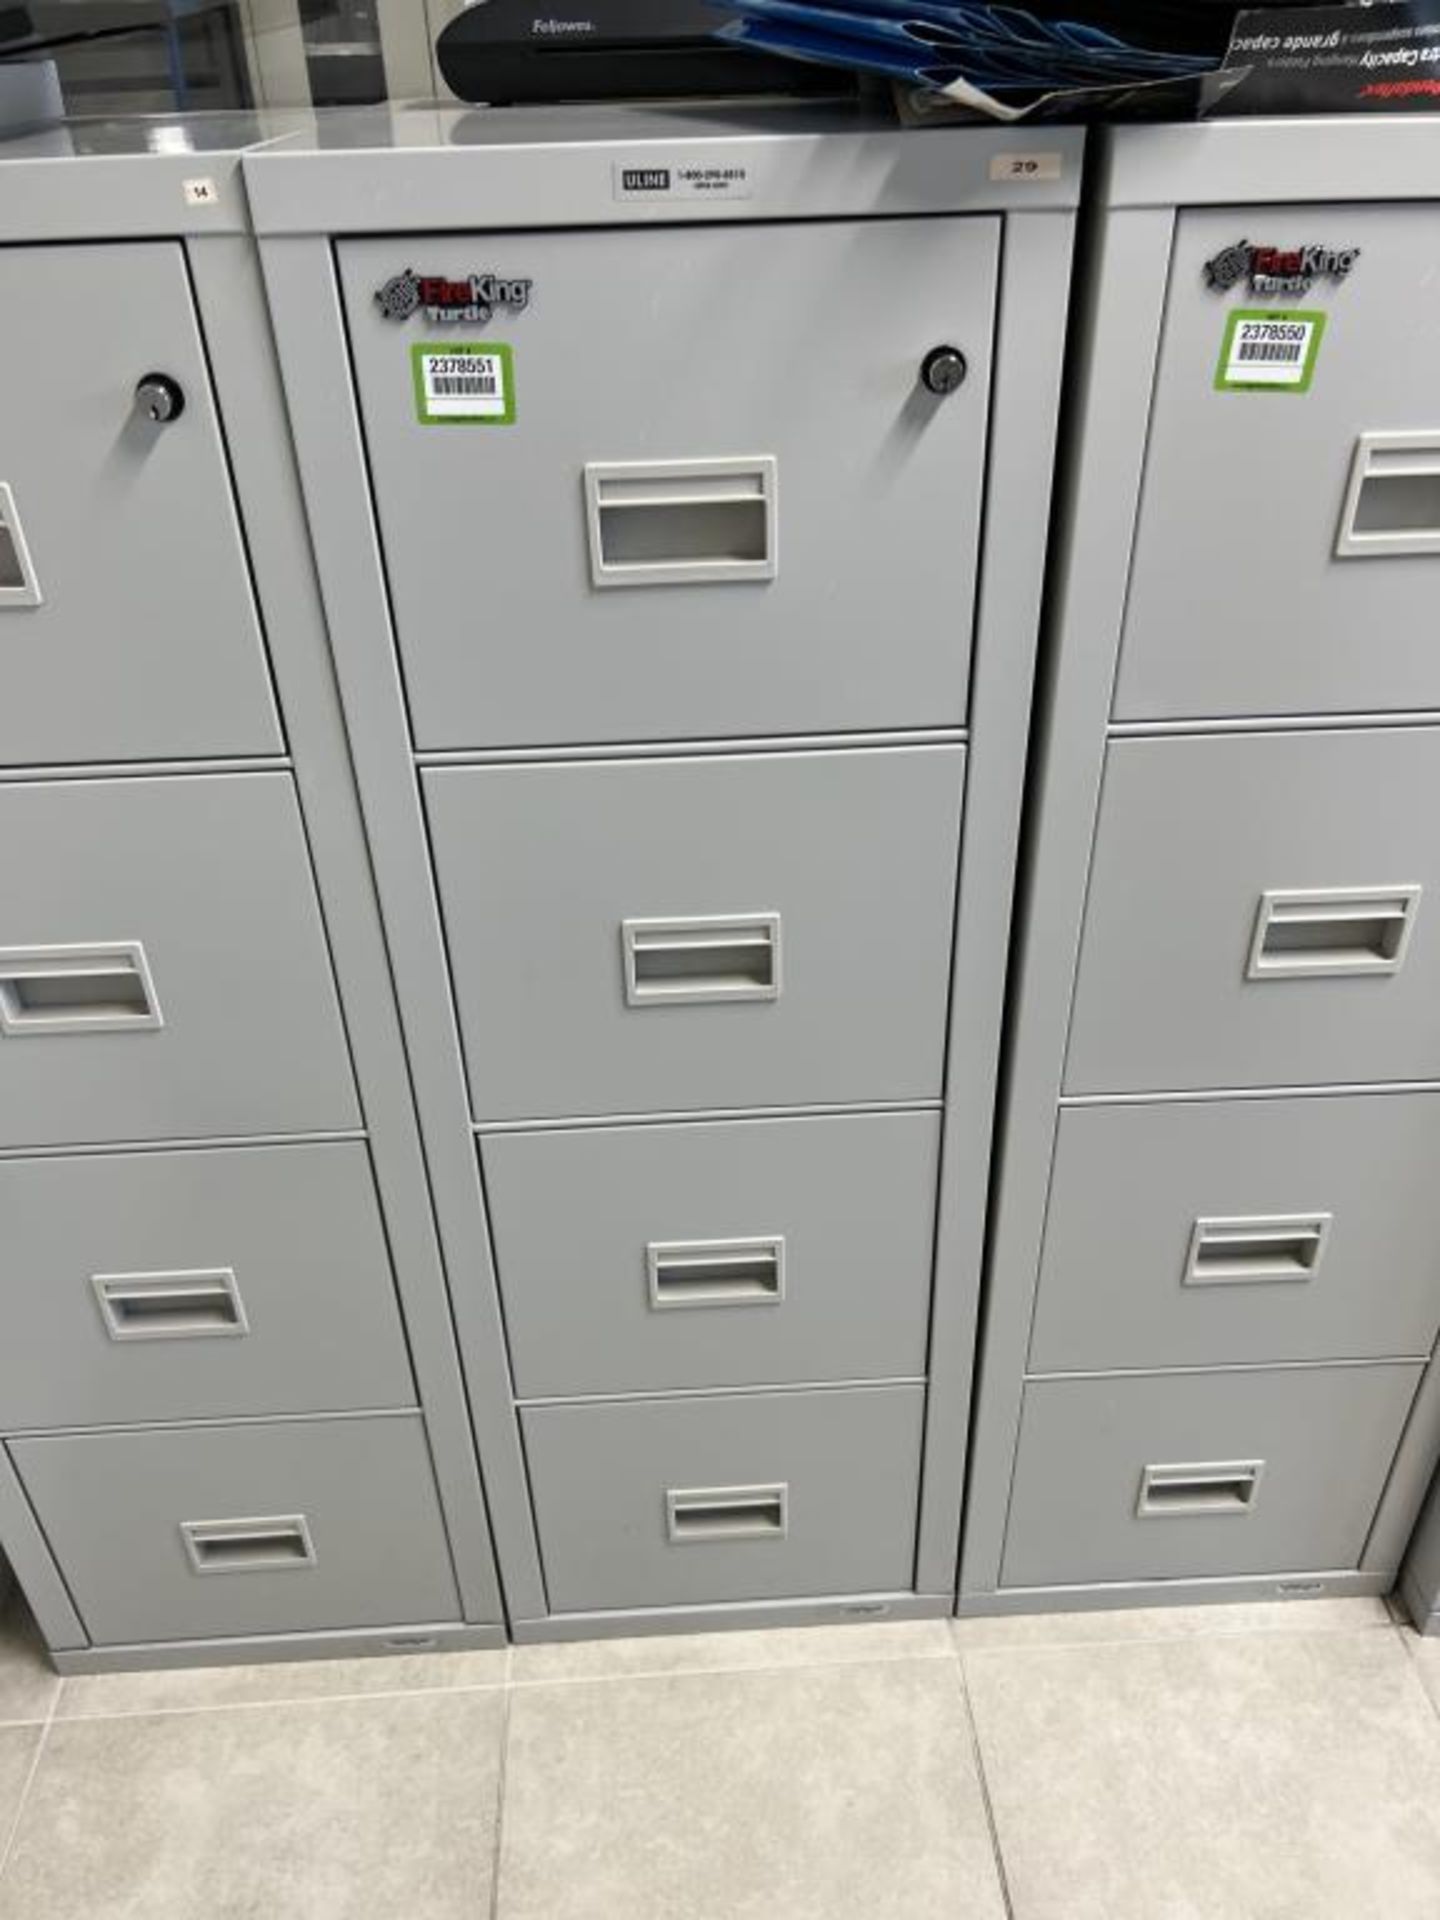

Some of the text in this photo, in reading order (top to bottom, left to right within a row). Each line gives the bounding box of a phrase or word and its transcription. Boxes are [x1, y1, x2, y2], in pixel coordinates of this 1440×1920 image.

[1360, 47, 1419, 70] Capacity
[1011, 159, 1038, 173] 29
[625, 172, 667, 188] ULINE
[193, 186, 208, 198] 14
[1255, 245, 1354, 274] FireKing
[422, 275, 530, 307] FireKing
[427, 305, 491, 321] Turtle
[1240, 323, 1305, 341] 2378550
[428, 357, 494, 374] 2378551
